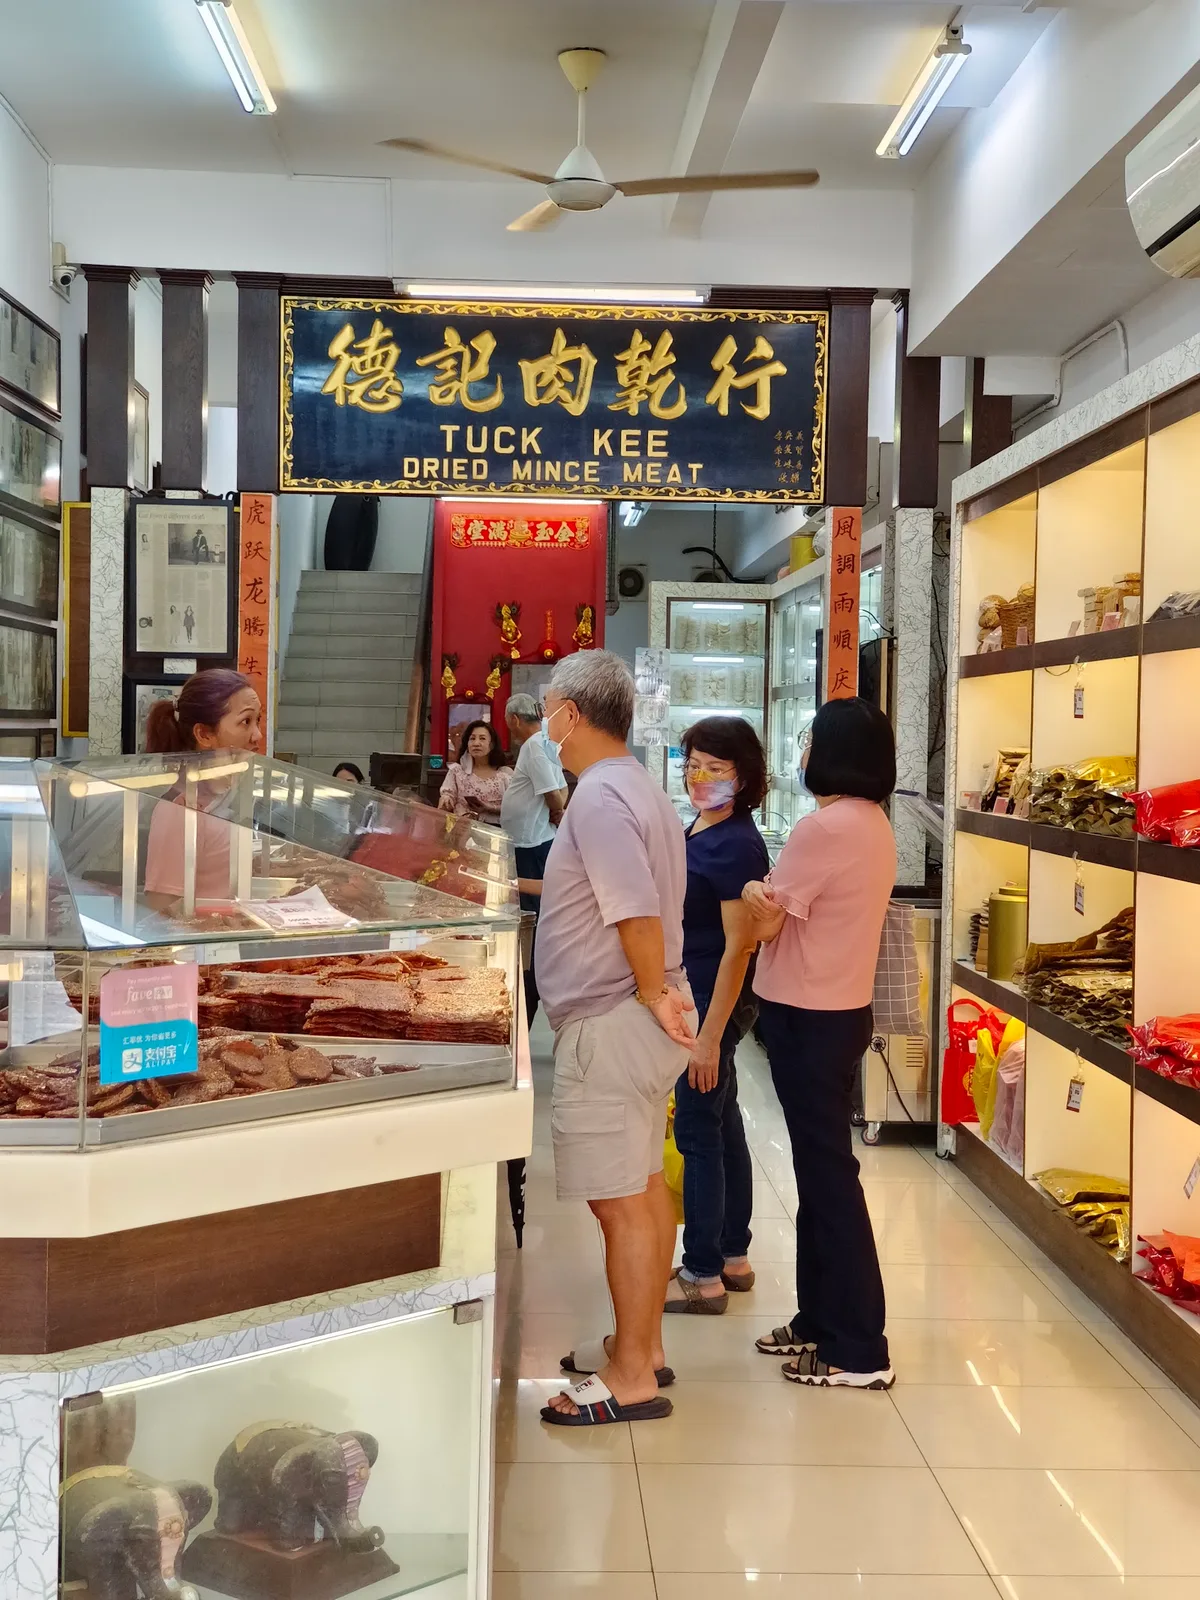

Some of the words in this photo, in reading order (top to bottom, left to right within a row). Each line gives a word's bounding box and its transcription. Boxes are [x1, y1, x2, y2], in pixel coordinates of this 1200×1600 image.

[321, 319, 787, 420] 德記肉乾行
[440, 424, 543, 454] TUCK
[593, 429, 669, 458] KEE
[403, 457, 488, 480] DRIED
[512, 459, 600, 483] MINCE
[623, 463, 704, 484] MEAT
[145, 1044, 176, 1061] 支付宝
[145, 1059, 176, 1068] ALIPAY
